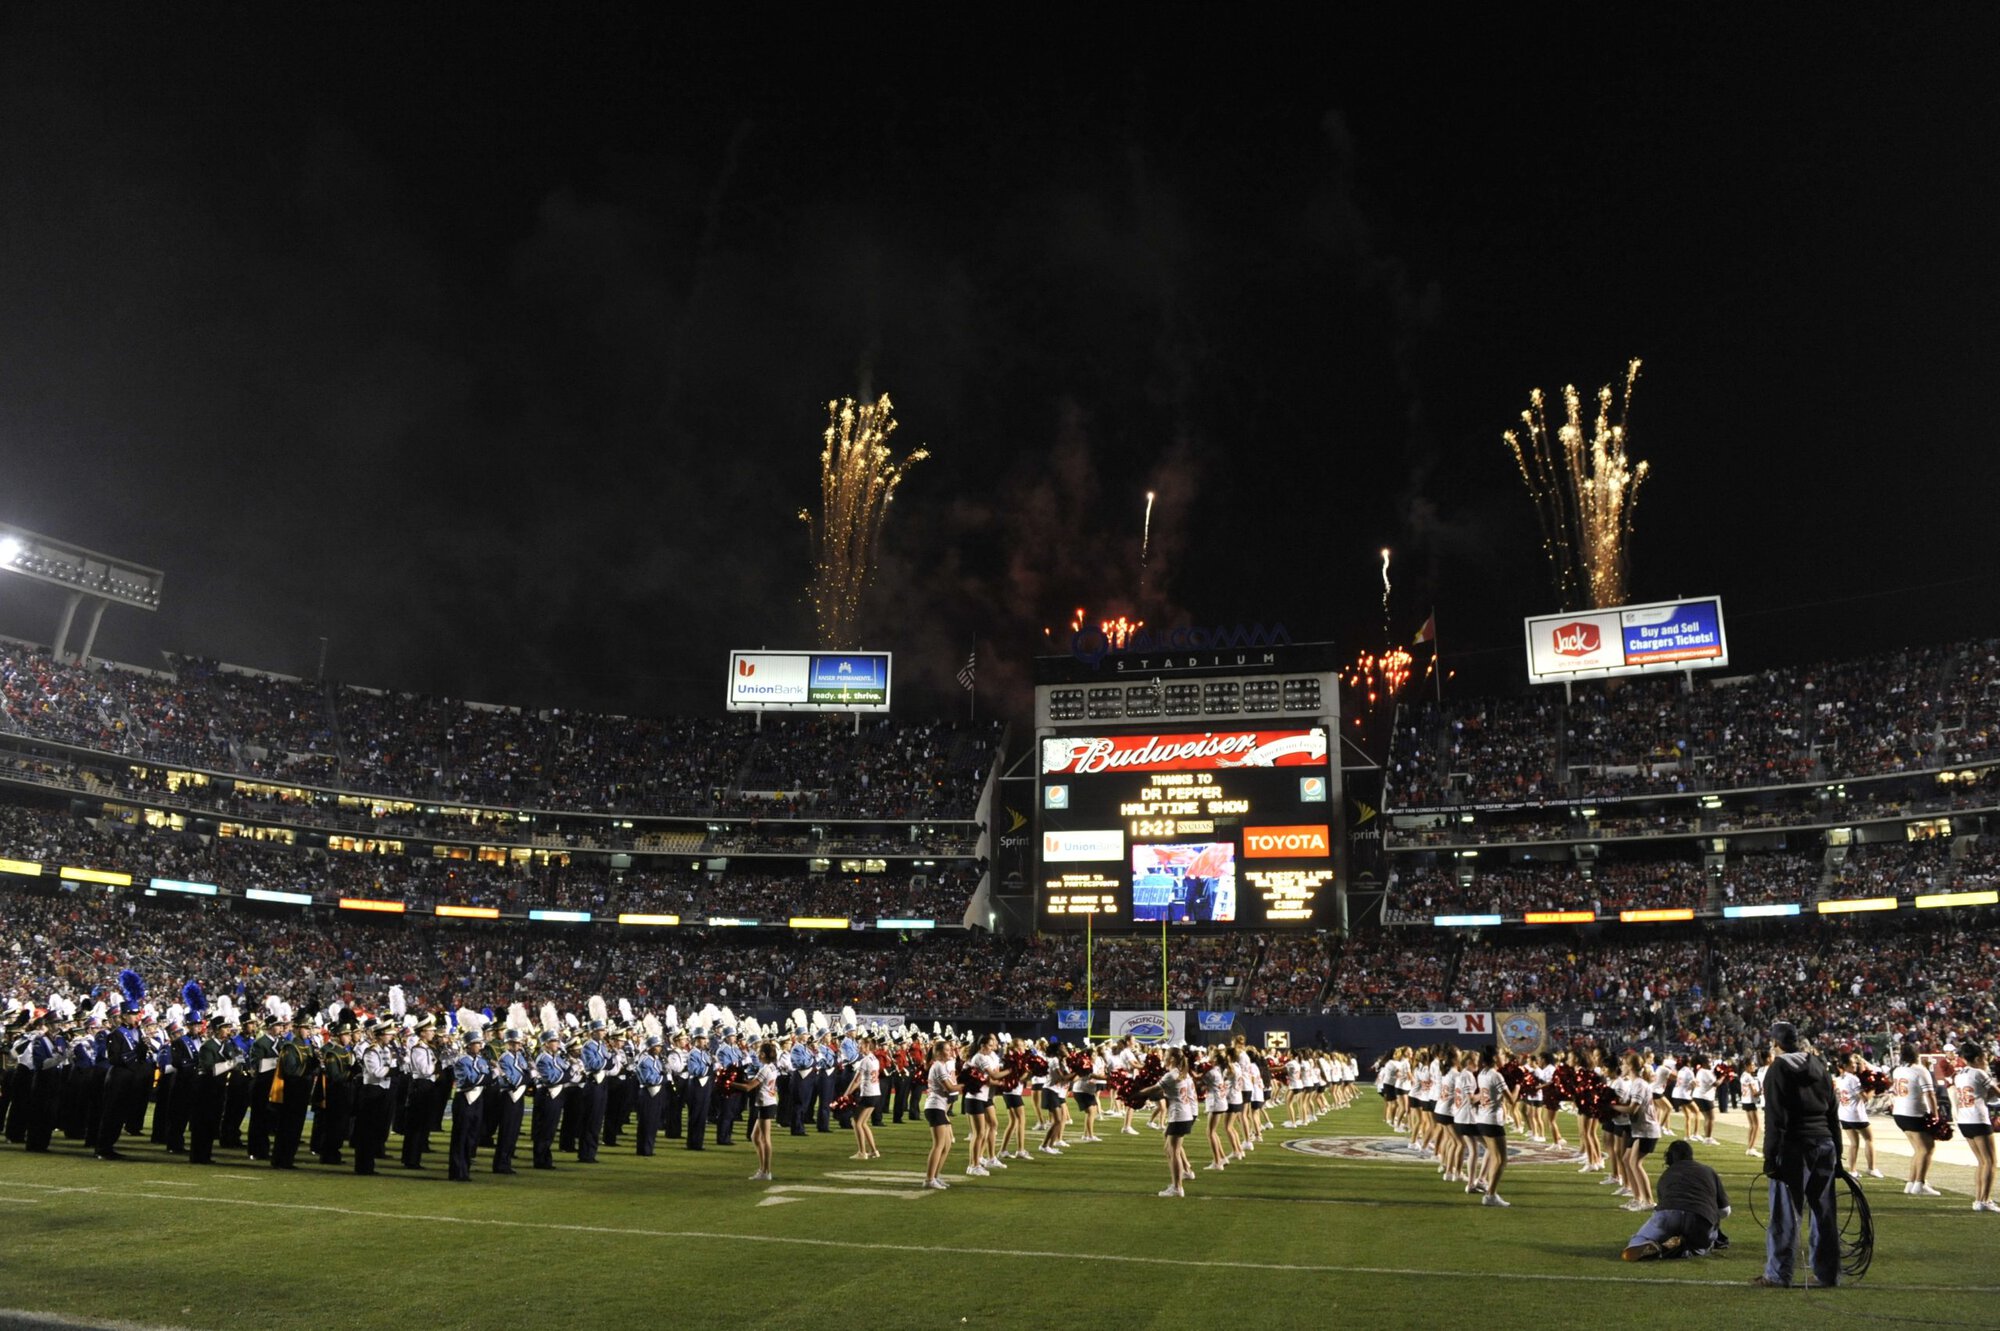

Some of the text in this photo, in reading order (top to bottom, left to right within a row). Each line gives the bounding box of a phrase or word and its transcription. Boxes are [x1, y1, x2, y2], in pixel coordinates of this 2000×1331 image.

[1641, 621, 1699, 638] Buy and Sell
[1555, 625, 1599, 653] Jack
[1630, 632, 1714, 650] Chargers Tickets!
[1117, 653, 1274, 670] STADIUM
[738, 684, 804, 695] UnionBank
[812, 692, 836, 700] ready.
[854, 692, 881, 700] thrive.
[1072, 732, 1257, 773] Budweiser
[1151, 773, 1213, 786] THANKS TO
[1141, 786, 1222, 801] DR PEPPER
[1120, 800, 1249, 816] HALFTIME SHOW
[1131, 820, 1175, 836] 12:22
[1347, 830, 1381, 840] Sprint
[1000, 836, 1030, 848] Sprint
[1247, 834, 1326, 850] TOYOTA
[1127, 1016, 1152, 1027] PACIFIC
[1464, 1014, 1485, 1032] N
[1267, 1032, 1288, 1048] 25
